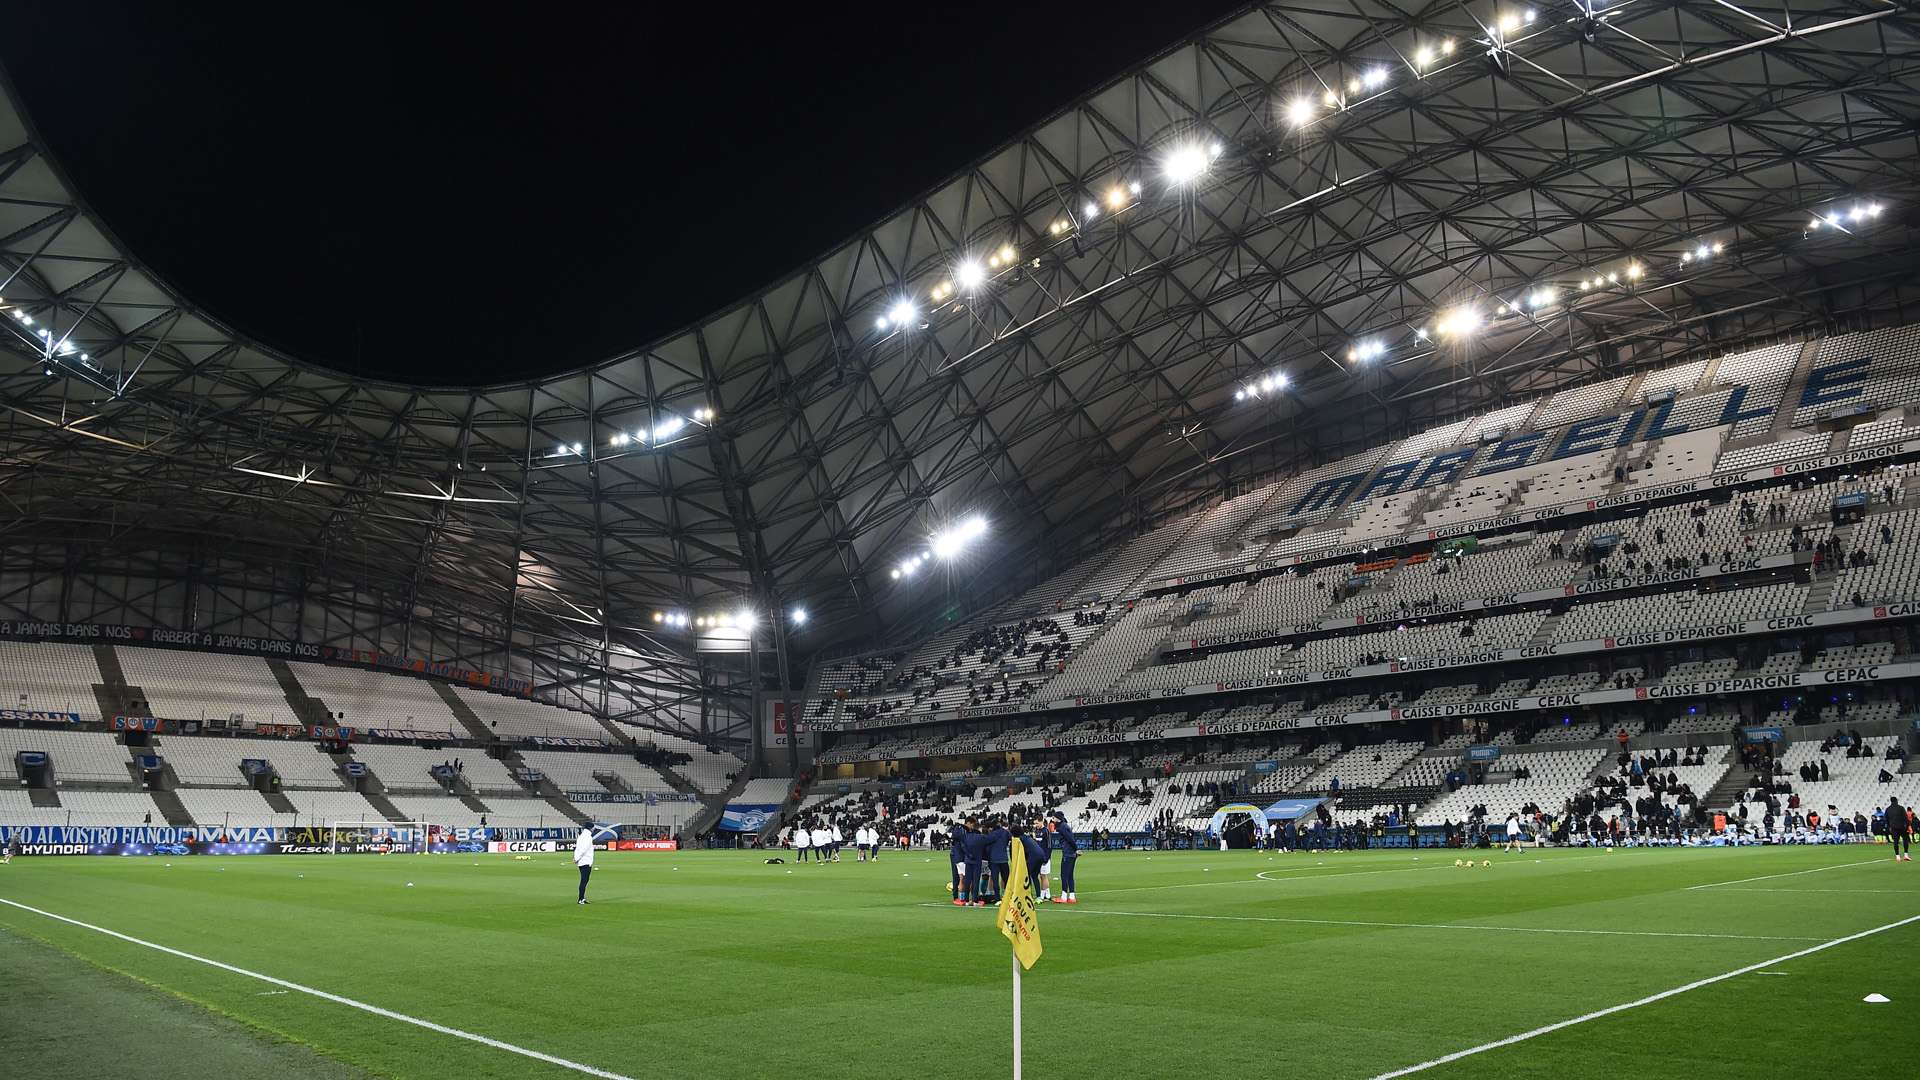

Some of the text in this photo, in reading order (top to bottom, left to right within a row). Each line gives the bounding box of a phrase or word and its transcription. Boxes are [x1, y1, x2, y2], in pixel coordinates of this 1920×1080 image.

[1287, 357, 1872, 516] MARSEILLE
[1785, 443, 1905, 474] CAISSE D'EPARGNE
[1596, 474, 1748, 508] CAISSE D'EPARGNE CEPAC
[1436, 507, 1565, 537] CAISSE D'EPARGNE CEPAC
[1301, 551, 1326, 561] CAISSE
[1384, 537, 1410, 547] CEPAC
[1183, 574, 1206, 584] CAISSE
[1256, 560, 1278, 570] CEPAC
[1576, 558, 1762, 594] CAISSE D'EPARGNE CEPAC
[1366, 595, 1518, 623] CAISSE D'EPARGNE CEPAC
[1, 622, 132, 639] A JAMAIS DANS NOS
[1200, 623, 1323, 647] CAISSE D'EPARGNE CEPAC
[1616, 614, 1814, 647] CAISSE D'EPARGNE CEPAC
[152, 629, 318, 657] RABERT A JAMAIS DANS NOS
[1400, 645, 1557, 671] CAISSE D'EPARGNE CEPAC
[1225, 668, 1352, 690] CAISSE D'EPARGNE CEPAC
[1649, 667, 1879, 698] CAISSE D'EPARGNE CEPAC
[1081, 697, 1105, 706] CAISSE
[1161, 687, 1187, 697] CEPAC
[1402, 694, 1581, 719] CAISSE D'EPARGNE CEPAC
[962, 710, 982, 718] CAISSE
[1030, 702, 1050, 711] CEPAC
[810, 723, 839, 731] CEPAC
[1207, 714, 1348, 735] CAISSE D'EPARGNE CEPAC
[925, 748, 946, 757] CAISSE
[995, 742, 1017, 751] CEPAC
[1051, 736, 1077, 746] CAISSE
[1137, 730, 1165, 740] CEPAC
[568, 793, 602, 802] VIEILLE
[37, 827, 57, 844] AL
[61, 826, 117, 844] VOSTRO
[509, 842, 547, 852] CEPAC
[22, 844, 88, 855] HYUNDAI
